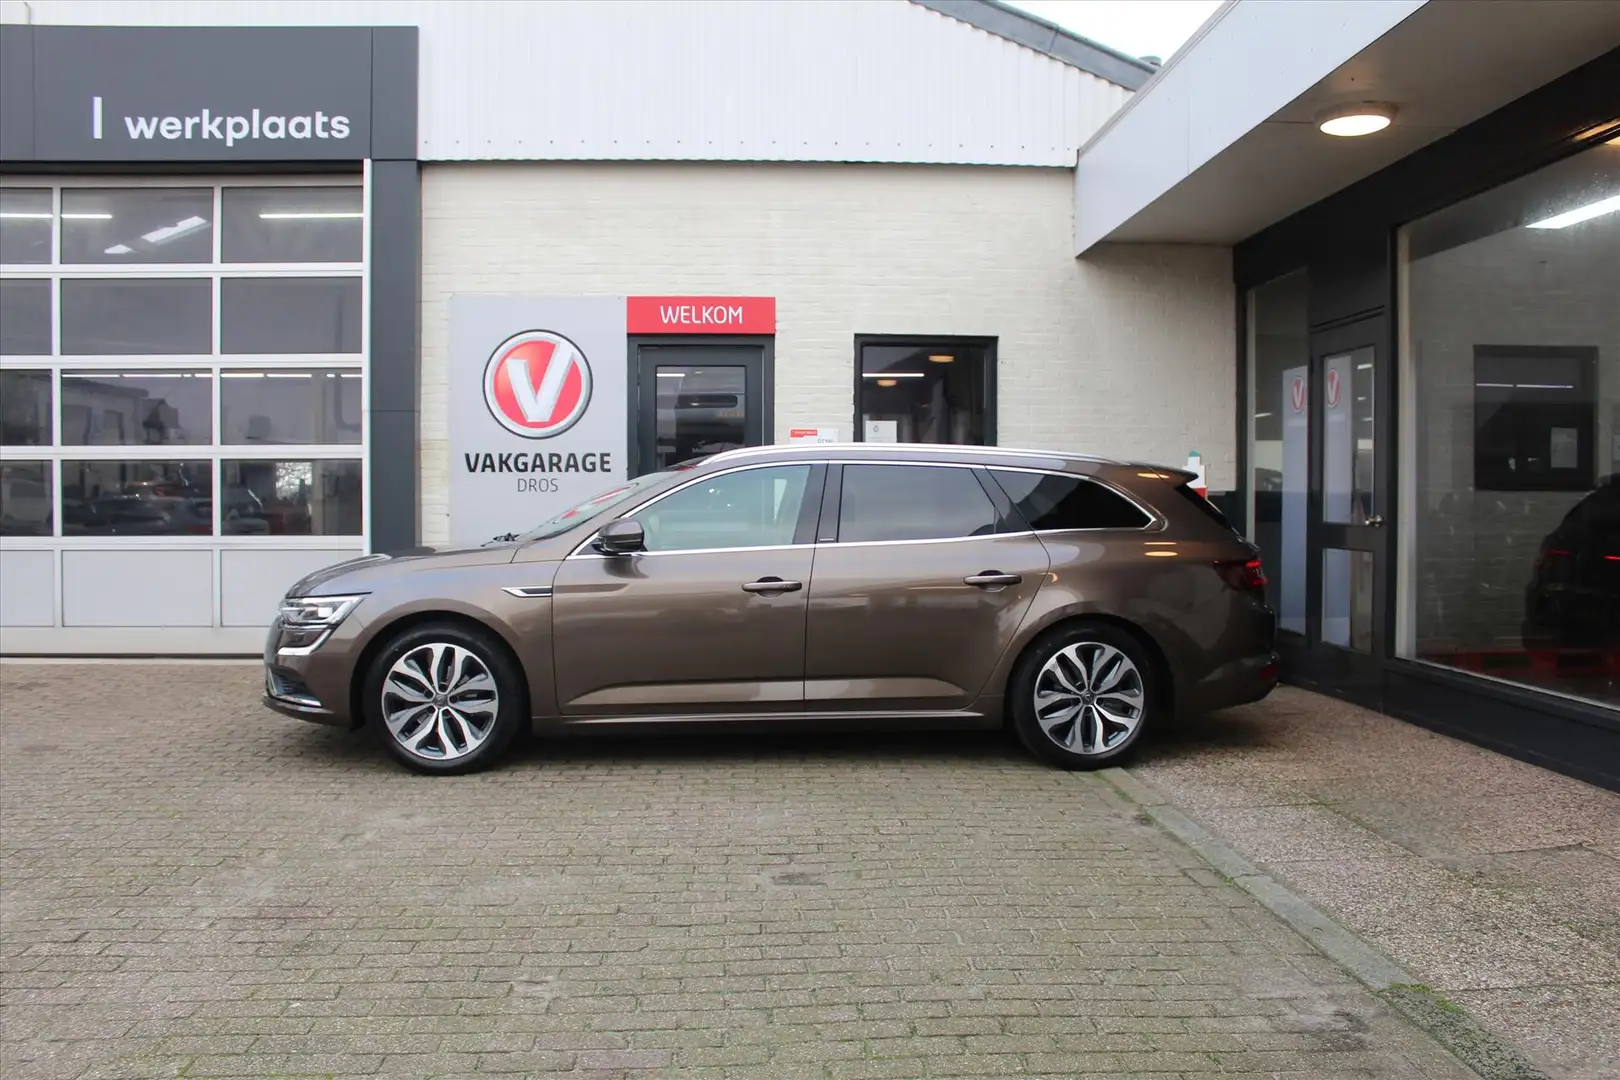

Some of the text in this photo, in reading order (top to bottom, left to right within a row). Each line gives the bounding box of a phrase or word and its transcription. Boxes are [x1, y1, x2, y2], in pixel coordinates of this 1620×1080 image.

[124, 108, 351, 147] werkplaats
[659, 305, 743, 325] WELKOM
[465, 452, 612, 473] VAKGARAGE
[517, 478, 559, 493] DROS
